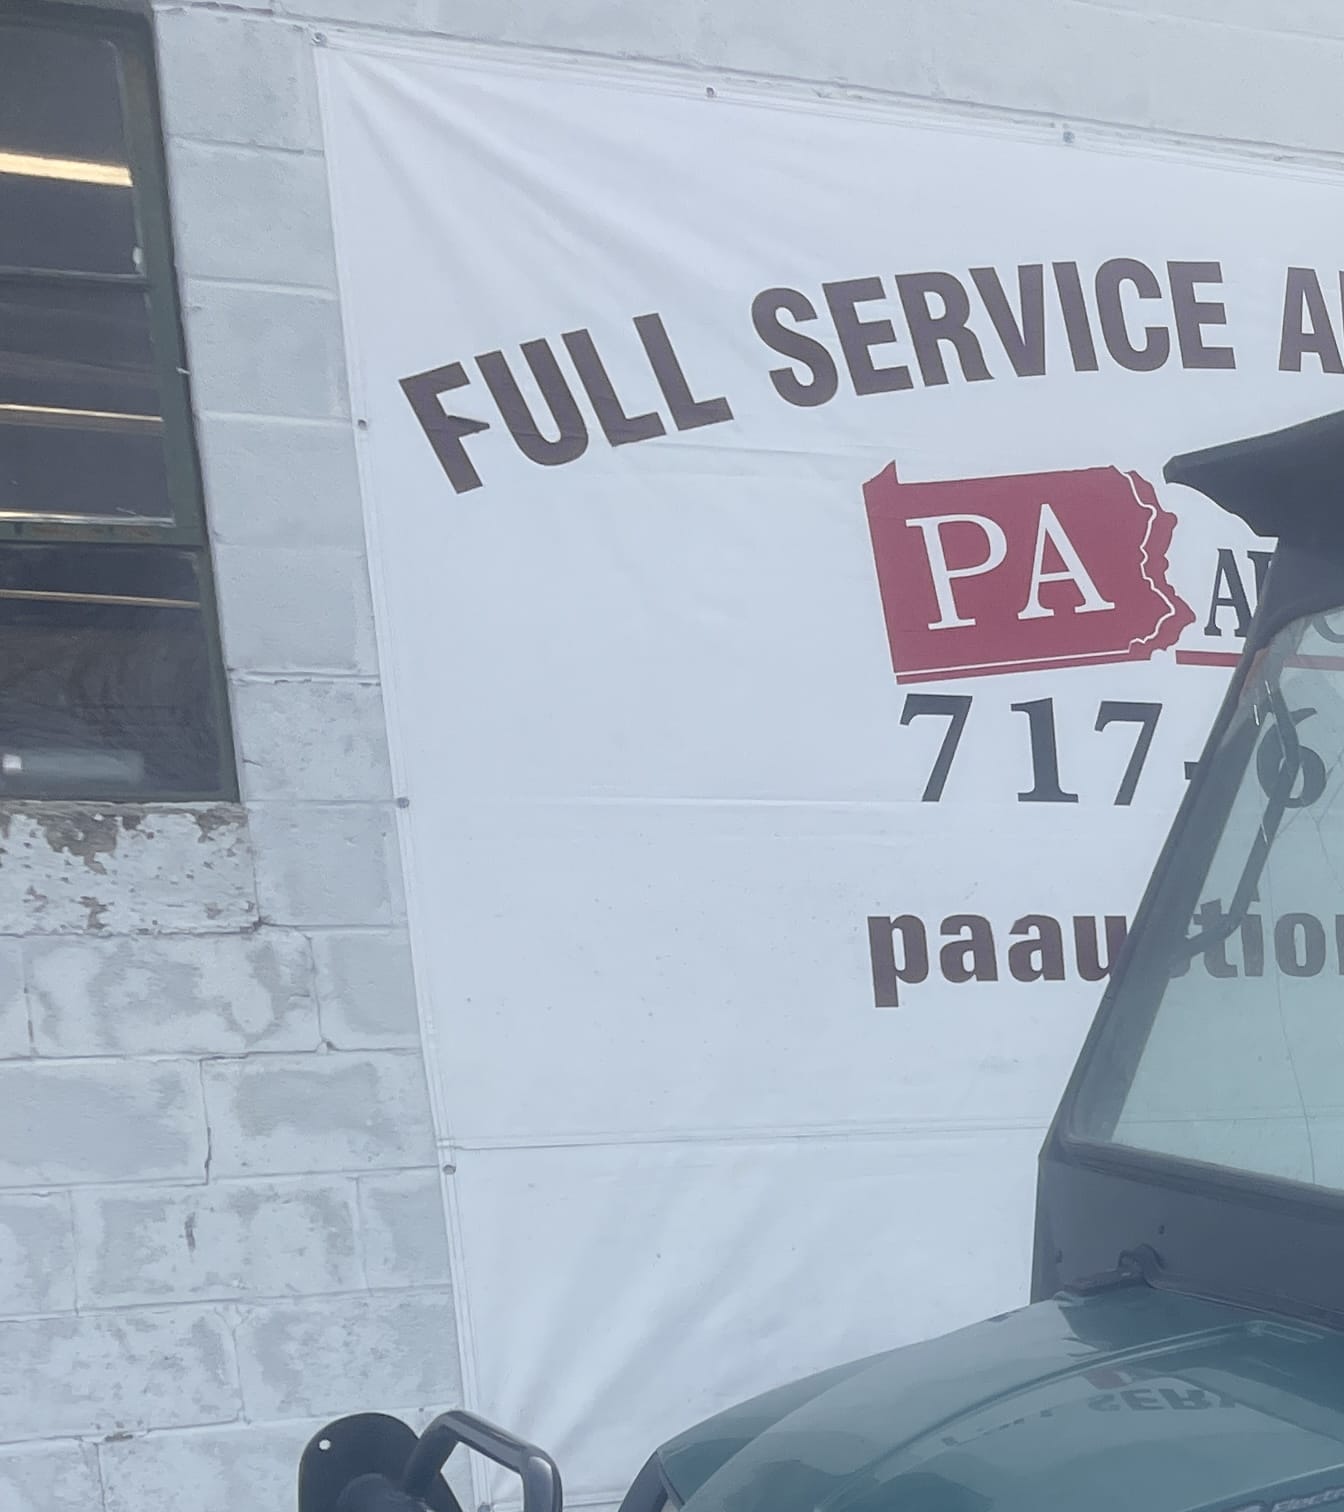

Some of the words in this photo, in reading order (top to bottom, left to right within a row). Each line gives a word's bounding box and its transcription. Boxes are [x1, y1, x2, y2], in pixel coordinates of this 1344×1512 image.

[399, 312, 734, 494] FULL
[751, 257, 1236, 408] SERVICE
[905, 503, 1116, 631] PA
